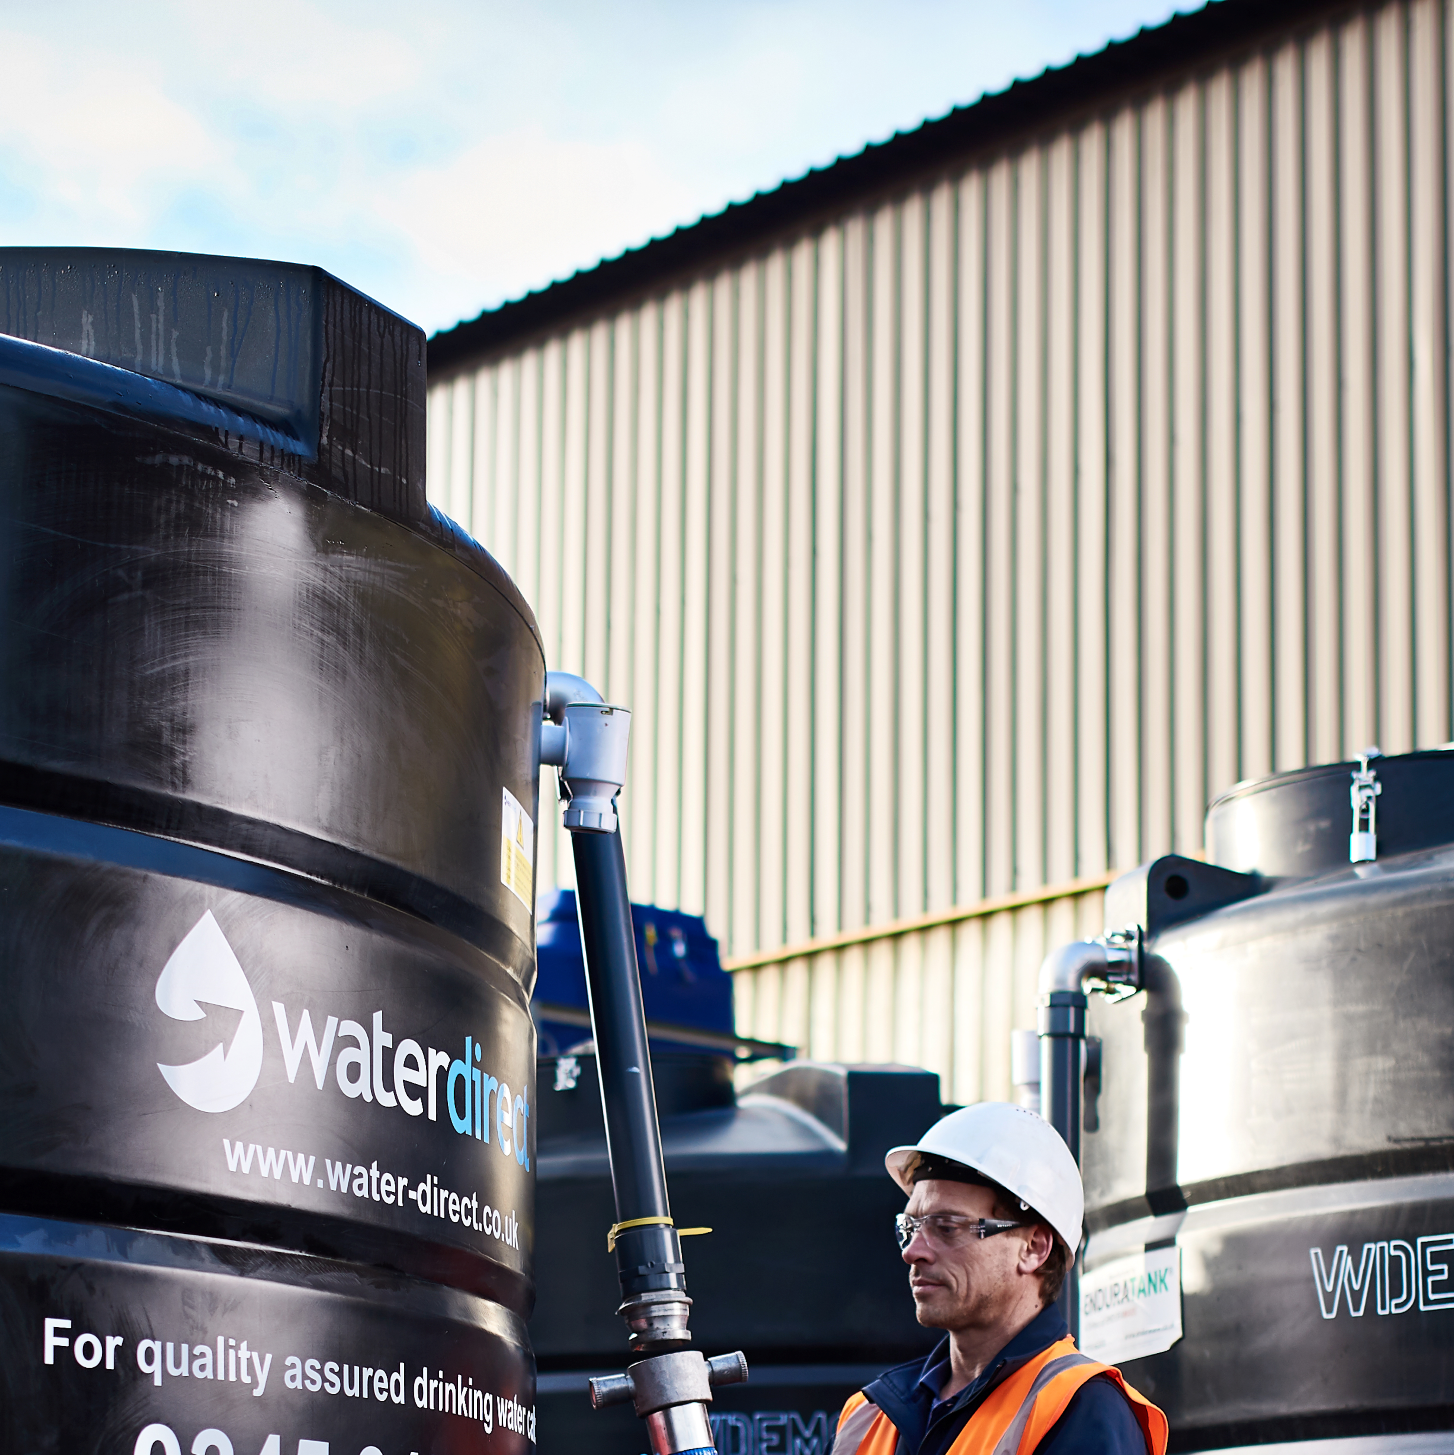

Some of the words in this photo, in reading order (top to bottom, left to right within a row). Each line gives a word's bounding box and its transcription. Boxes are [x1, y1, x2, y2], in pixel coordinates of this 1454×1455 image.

[271, 1000, 530, 1173] waterdirect
[222, 1138, 520, 1250] www.water-direct.co.uk
[1083, 1267, 1170, 1316] ENDURATANK
[43, 1317, 124, 1370] For
[136, 1335, 273, 1397] quality
[283, 1355, 406, 1405] assured
[412, 1366, 493, 1435] drinking
[496, 1393, 527, 1436] water
